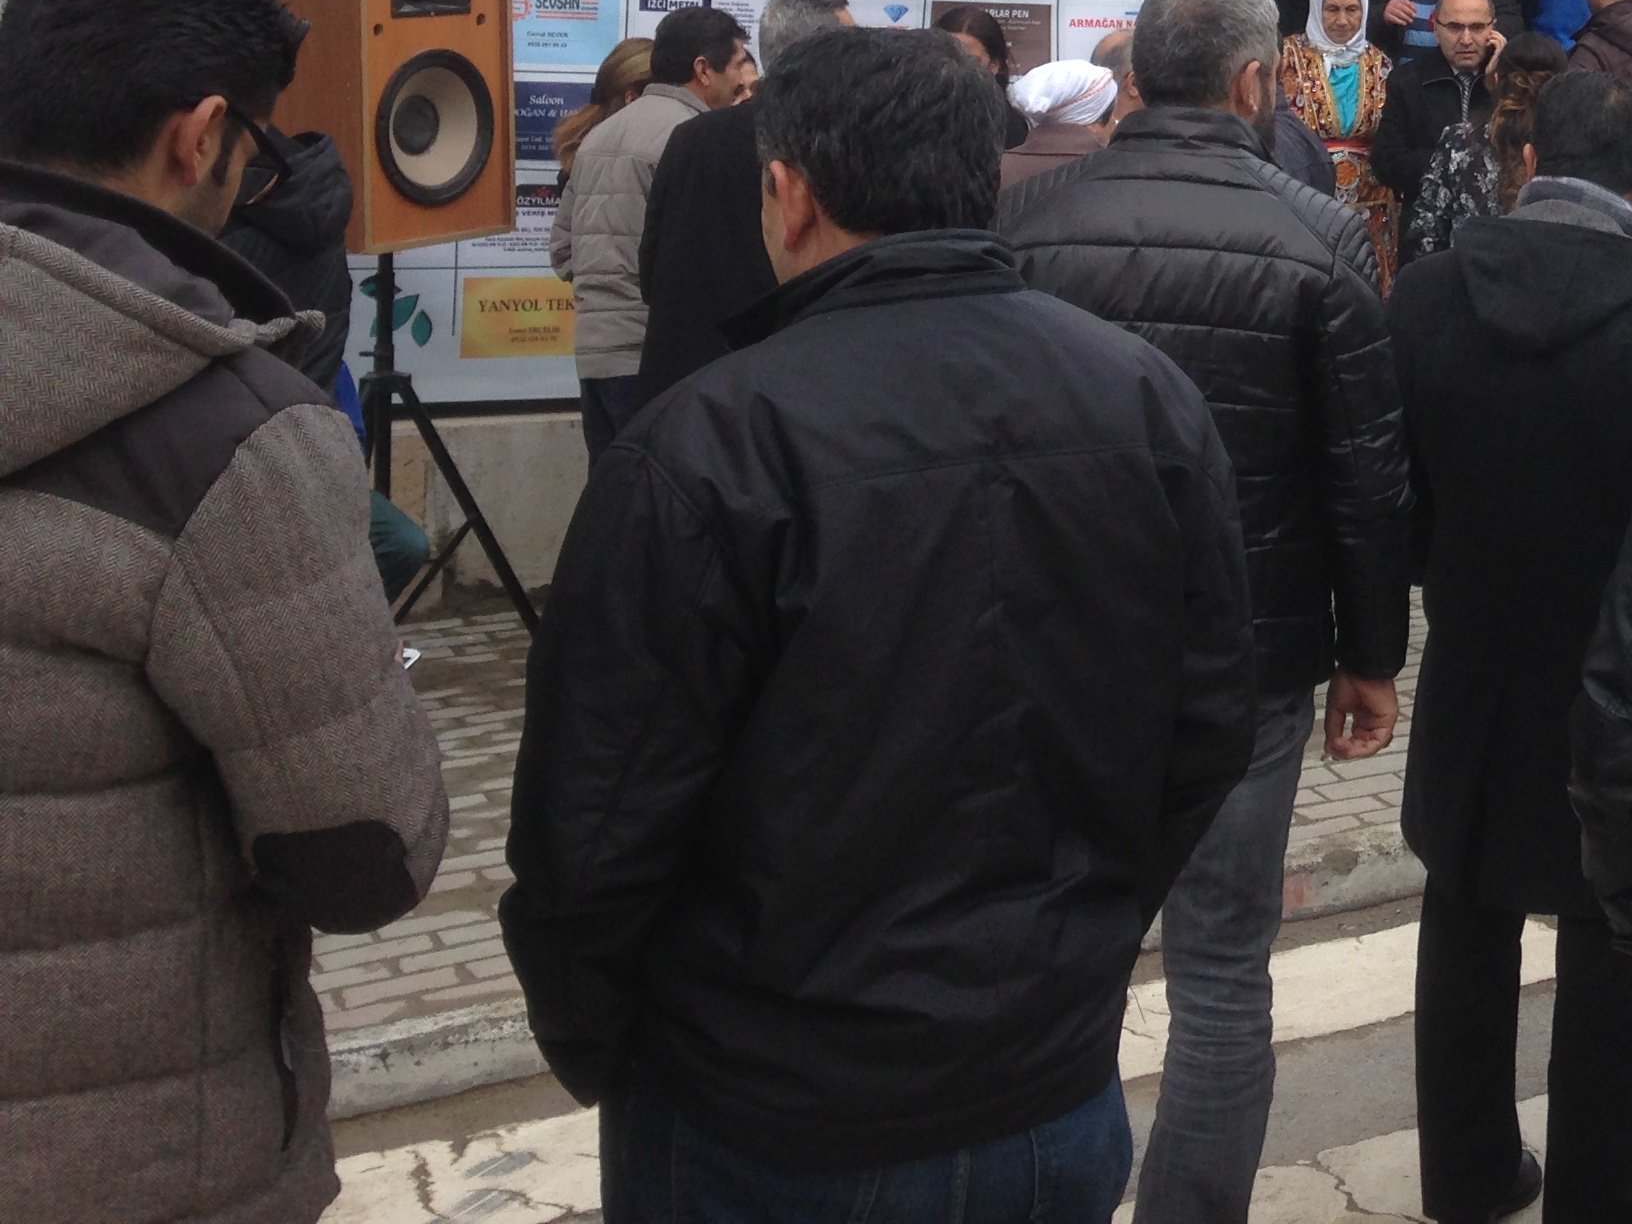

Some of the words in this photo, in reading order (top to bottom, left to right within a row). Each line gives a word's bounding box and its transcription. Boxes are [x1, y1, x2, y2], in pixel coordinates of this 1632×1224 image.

[1011, 9, 1029, 19] PEN
[1068, 17, 1123, 28] ARMAĞAN
[529, 94, 564, 105] Saloon
[478, 298, 542, 313] YANYOL
